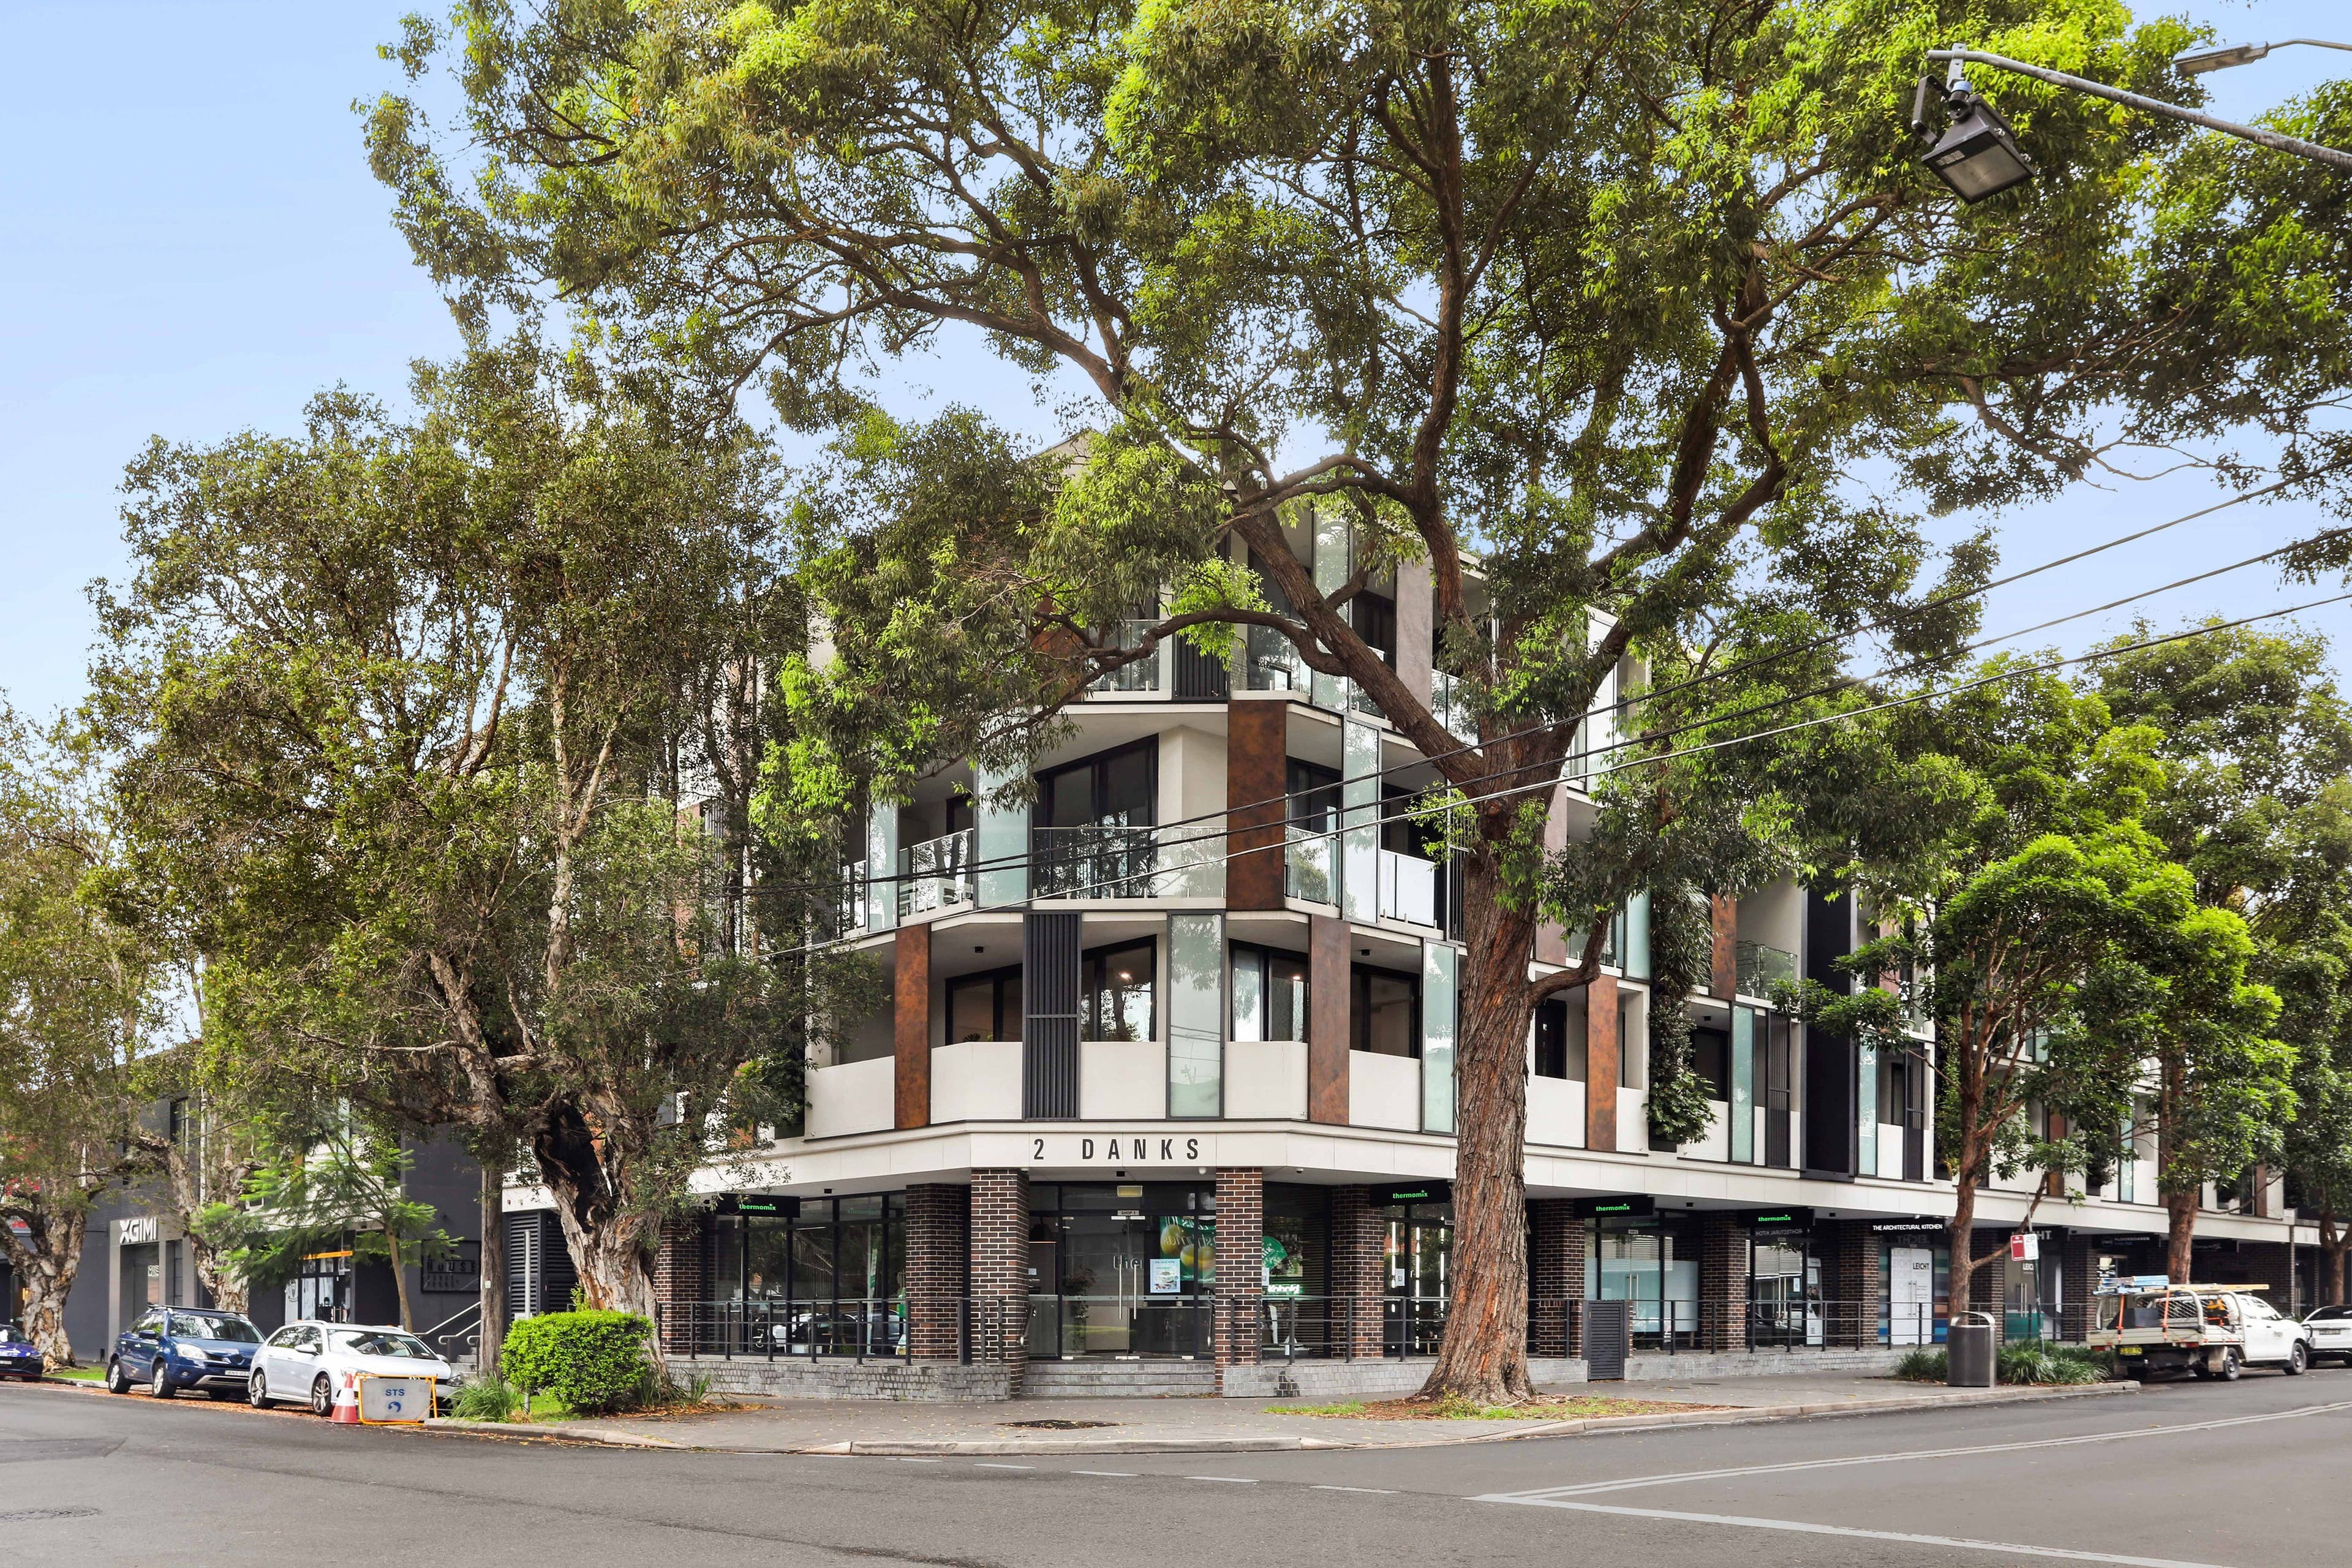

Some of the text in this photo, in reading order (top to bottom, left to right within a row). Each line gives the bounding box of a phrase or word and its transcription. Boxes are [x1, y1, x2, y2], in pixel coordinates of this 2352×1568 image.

[1034, 1139, 1198, 1159] 2 DANKS
[1393, 1189, 1428, 1199] thermomix
[119, 1217, 157, 1243] XGIMI
